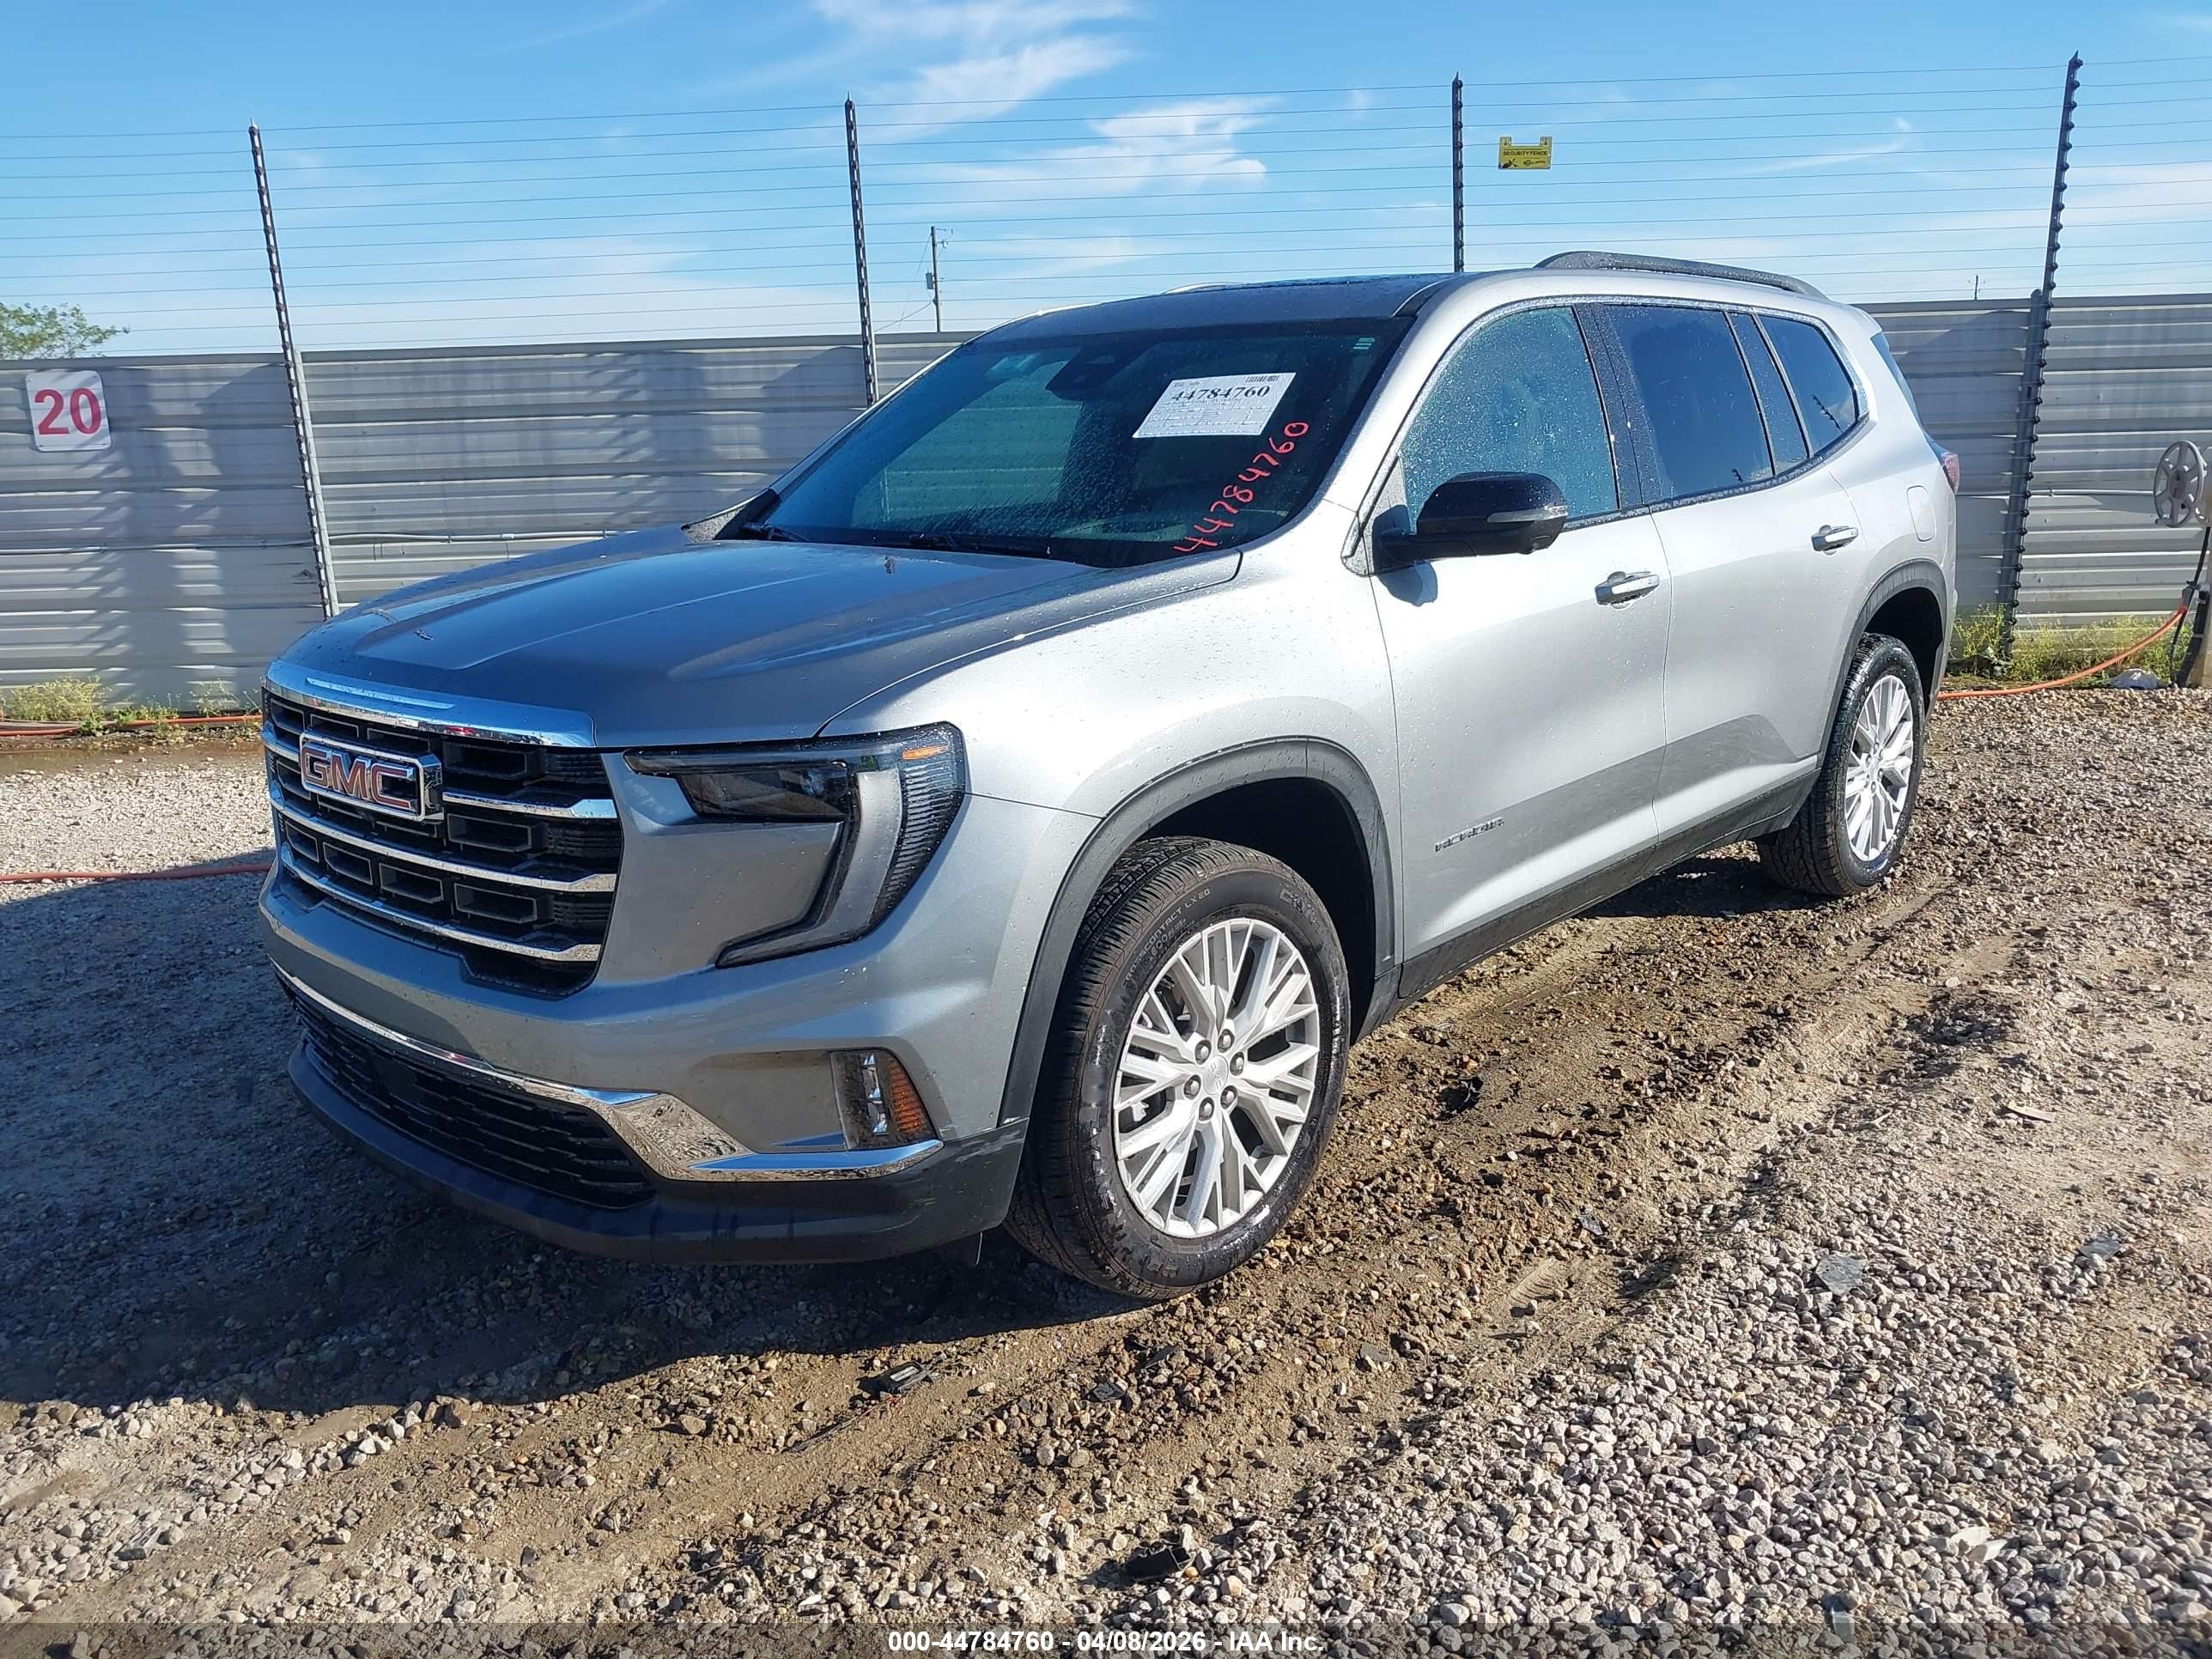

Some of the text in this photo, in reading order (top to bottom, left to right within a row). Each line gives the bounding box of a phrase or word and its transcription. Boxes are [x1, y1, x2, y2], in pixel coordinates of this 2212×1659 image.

[34, 387, 101, 434] 20
[1171, 385, 1270, 400] 44784760
[1173, 422, 1310, 552] 44784760
[301, 741, 416, 811] GMC
